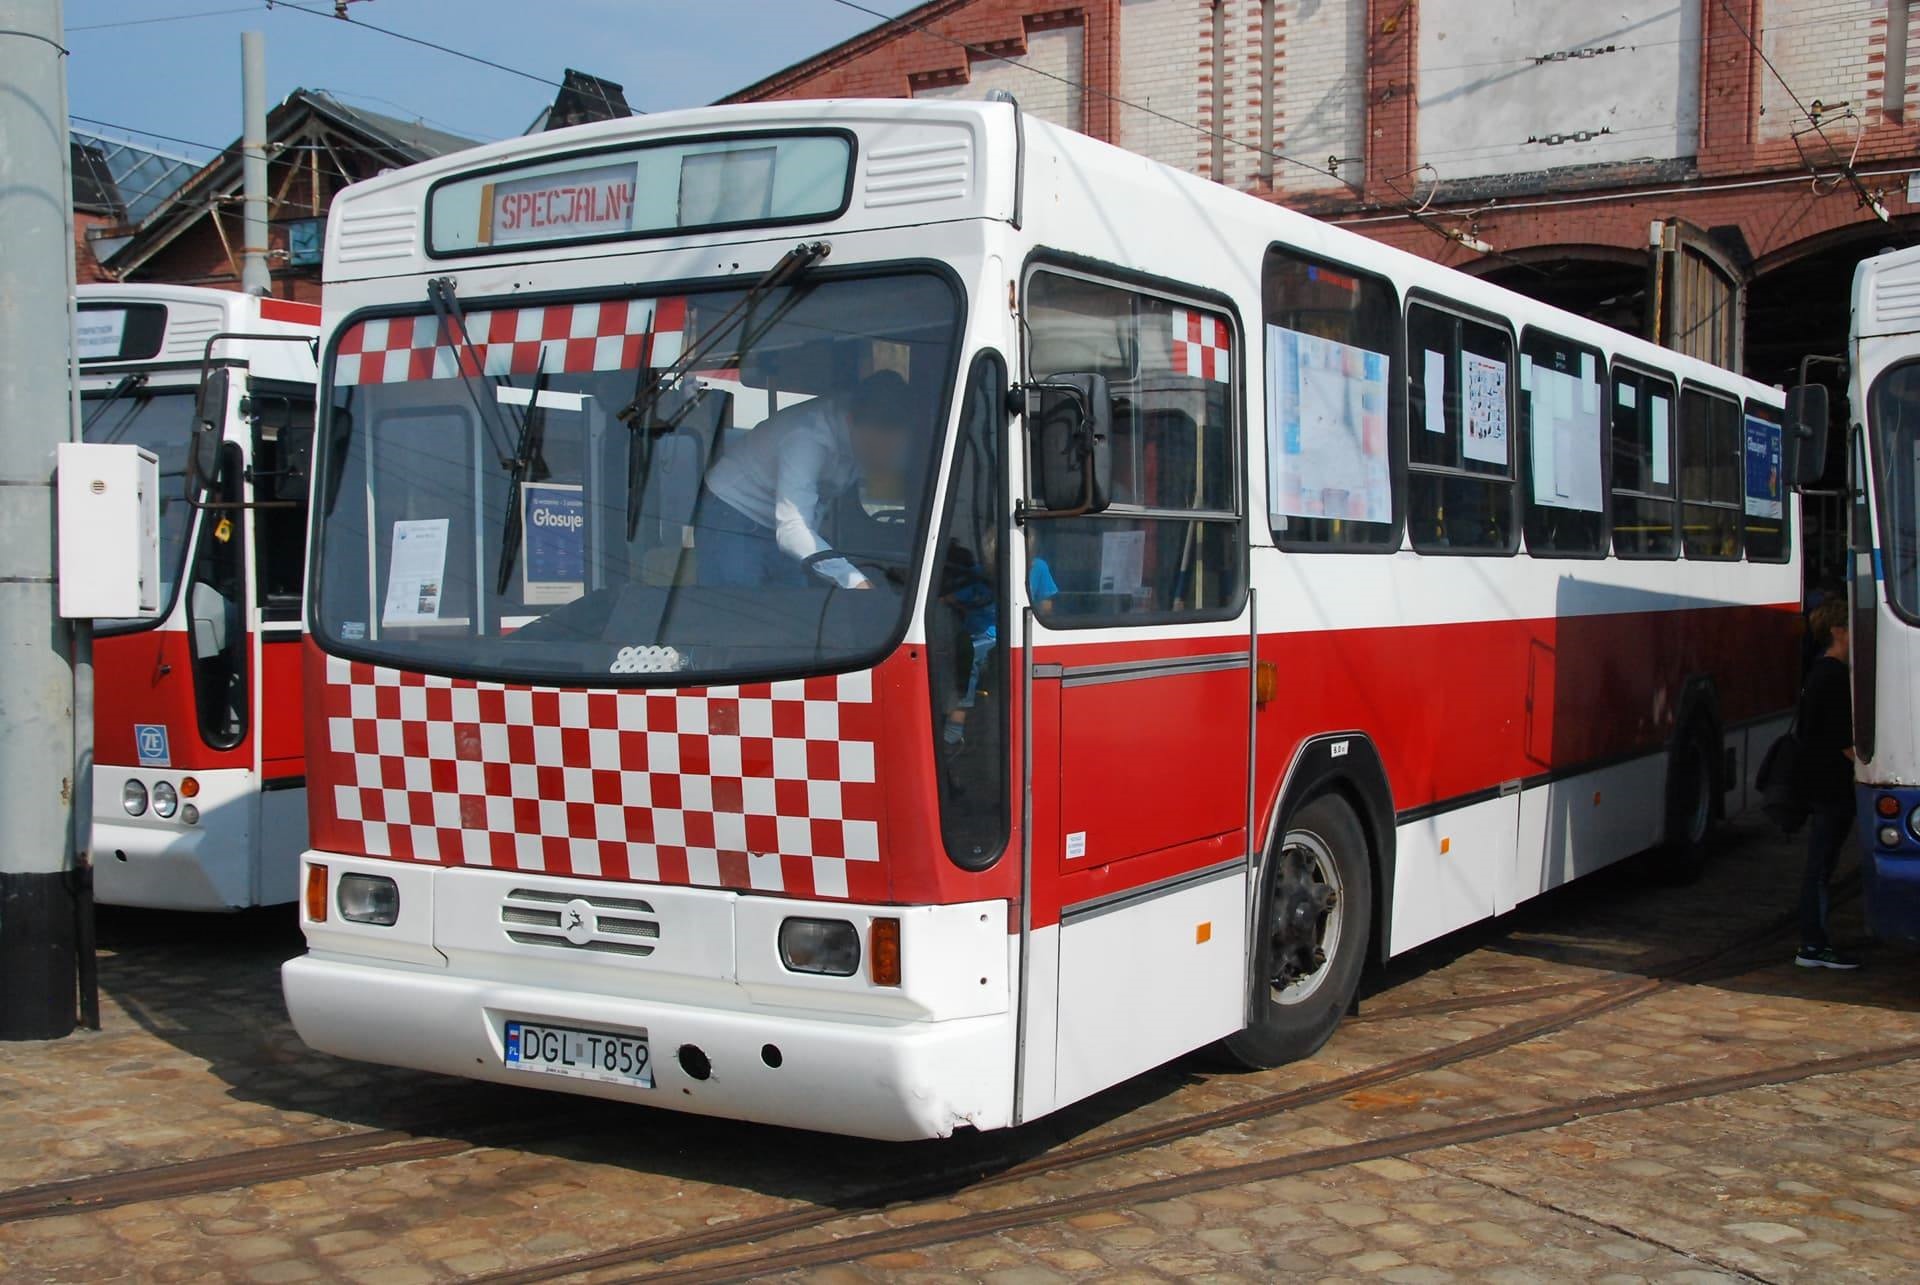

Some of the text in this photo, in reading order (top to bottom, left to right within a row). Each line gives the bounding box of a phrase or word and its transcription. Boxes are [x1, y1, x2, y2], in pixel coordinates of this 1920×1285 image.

[502, 183, 636, 229] SPECJALNY
[533, 507, 584, 533] Głosuje
[508, 1047, 519, 1056] PL
[523, 1029, 649, 1076] DGL T859
